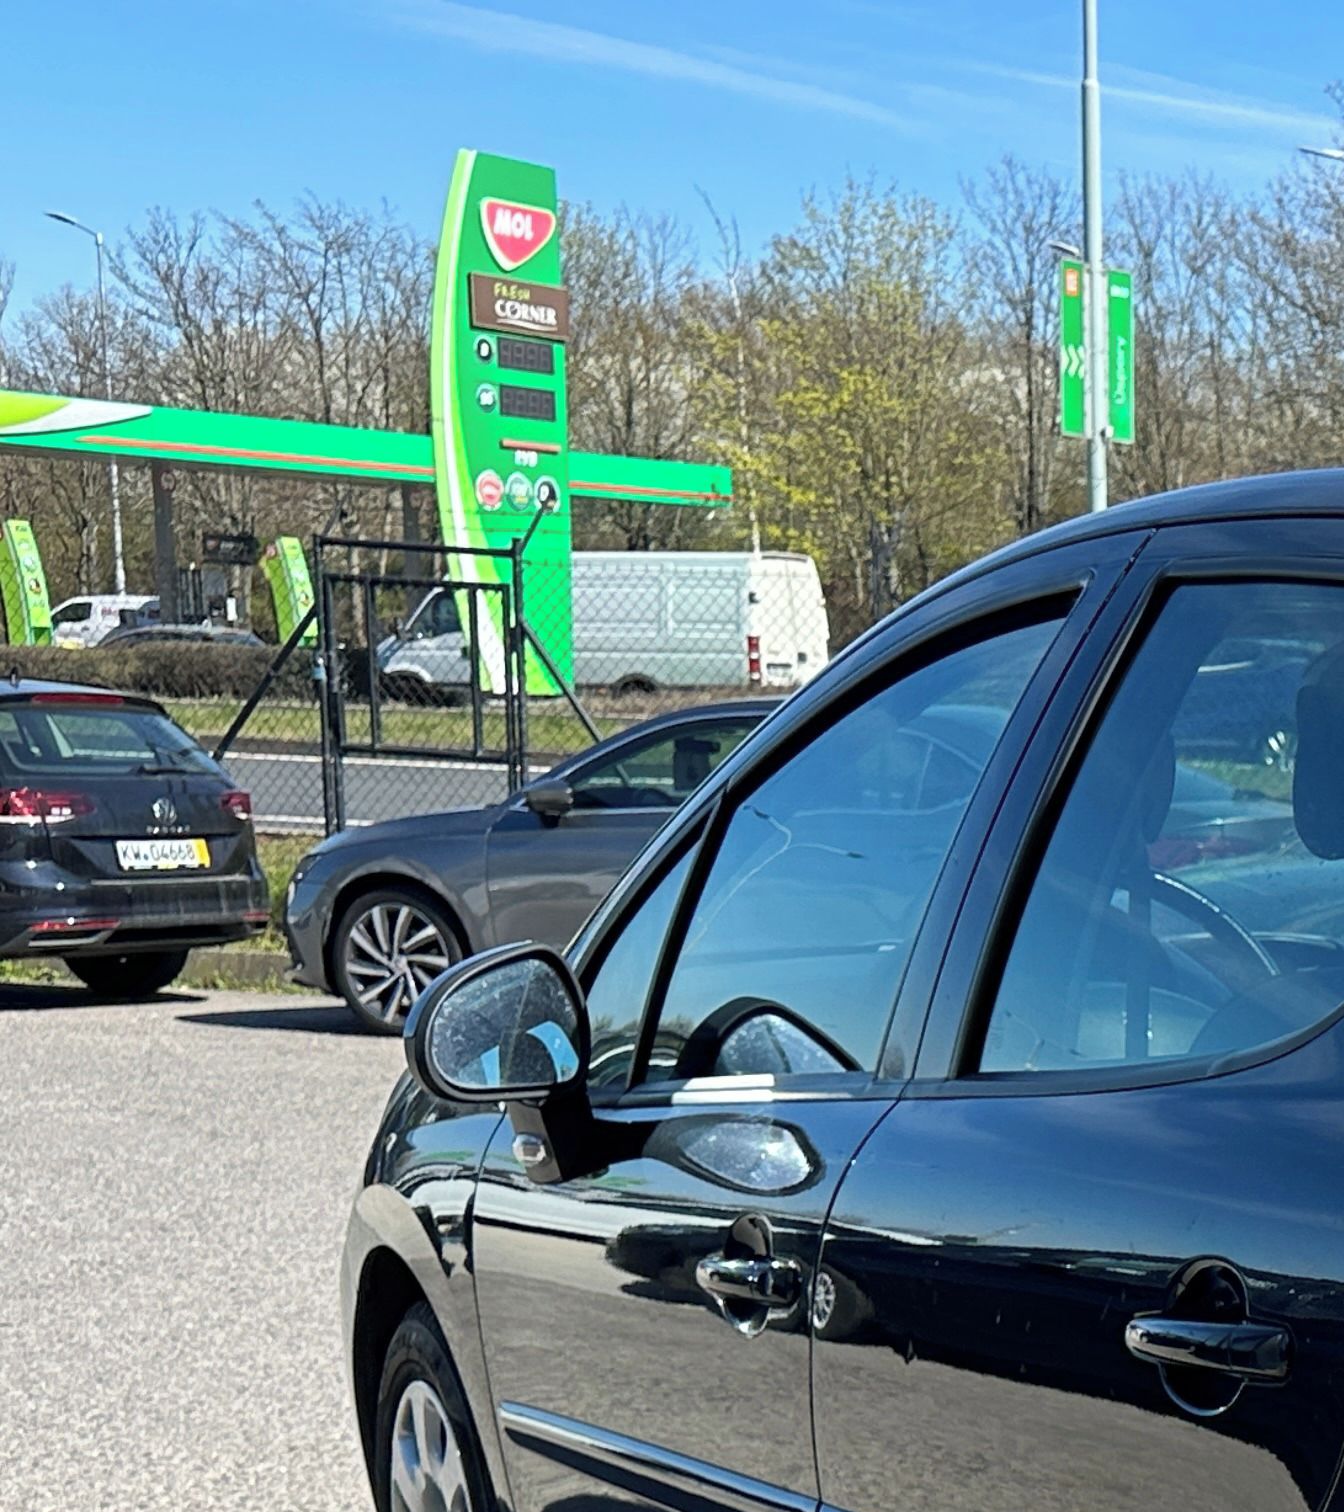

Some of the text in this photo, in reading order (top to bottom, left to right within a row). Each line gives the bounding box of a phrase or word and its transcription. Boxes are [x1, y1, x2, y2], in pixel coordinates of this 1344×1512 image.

[493, 207, 534, 240] MOL
[494, 282, 531, 300] FRESH
[495, 299, 558, 325] CORNER
